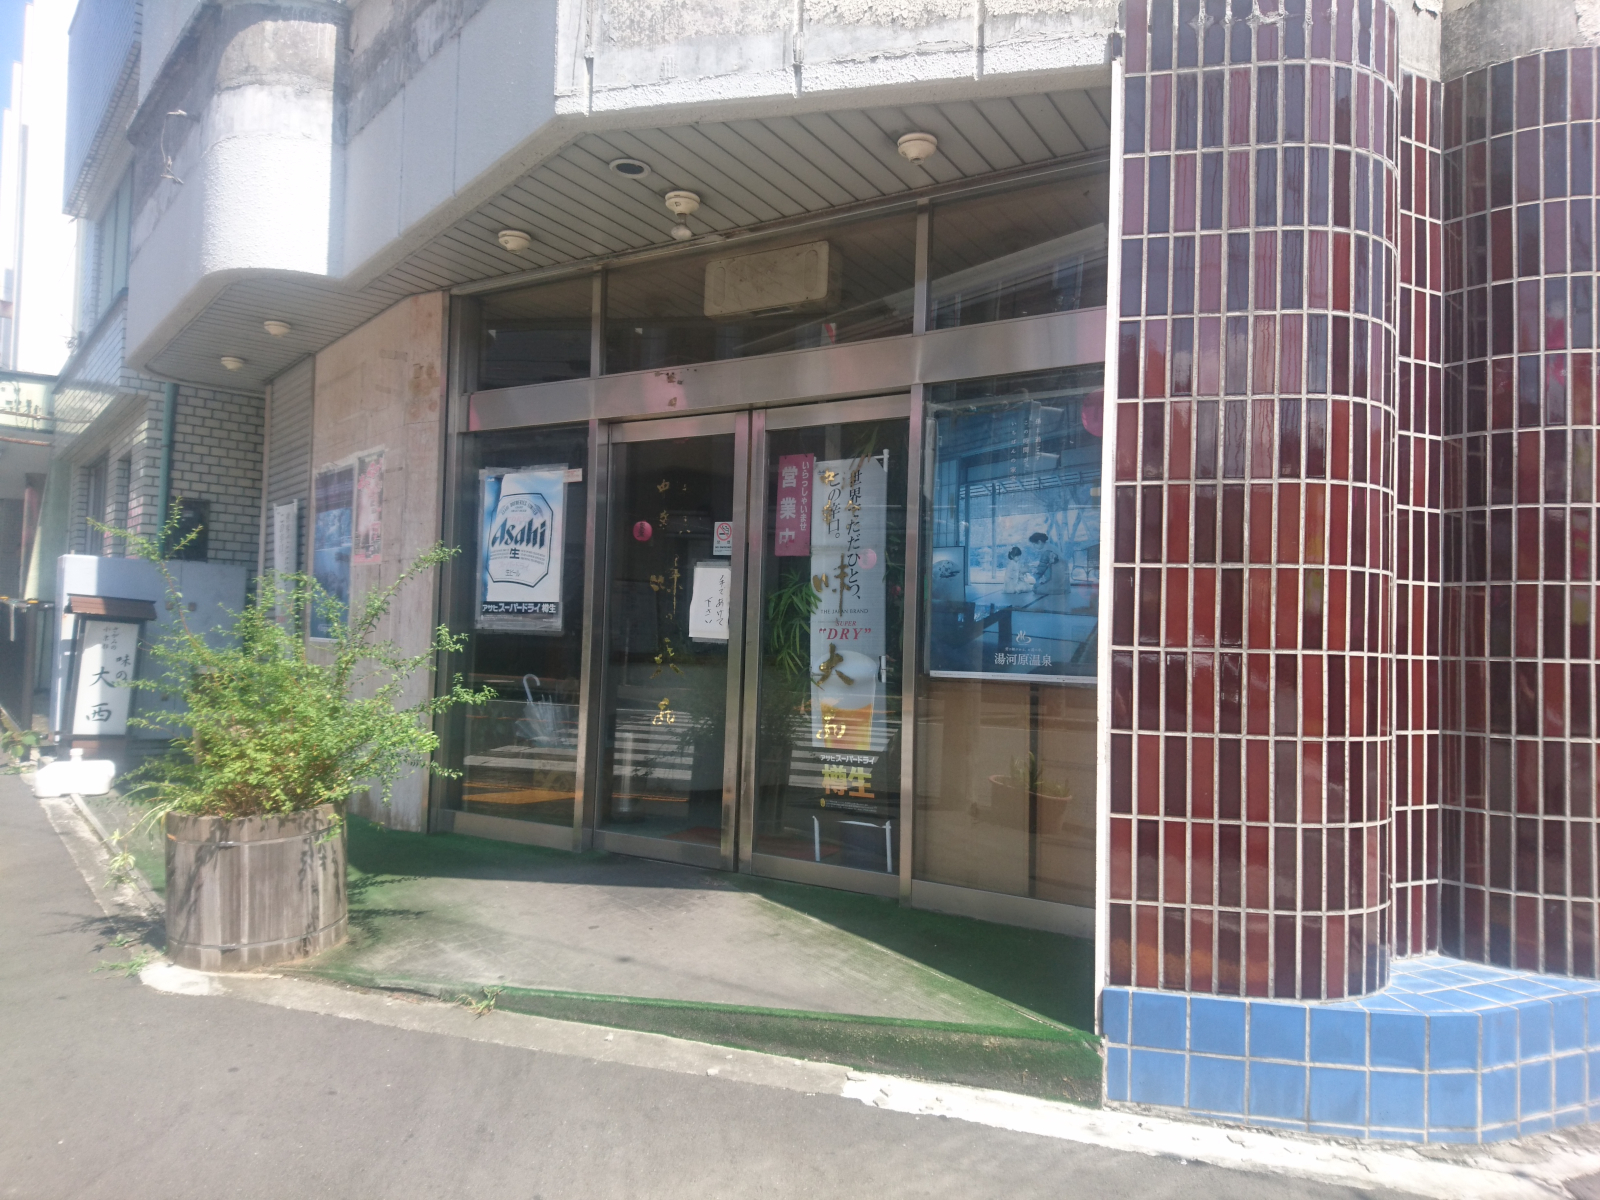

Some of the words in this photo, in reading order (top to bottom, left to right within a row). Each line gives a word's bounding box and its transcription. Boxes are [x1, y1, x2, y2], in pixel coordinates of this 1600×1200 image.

[778, 465, 798, 546] 営業中
[799, 461, 810, 532] いらっしゃいませ
[491, 517, 547, 549] Asahi
[509, 547, 520, 560] 生
[482, 602, 540, 613] アサヒスーパードライ
[541, 603, 557, 614] 樽生
[704, 596, 713, 624] 下さい
[115, 653, 131, 681] 味の
[994, 652, 1053, 667] 湯河原温泉
[86, 666, 115, 723] 大西
[820, 754, 875, 765] アサヒスーパードライ
[821, 763, 875, 799] 樽生
